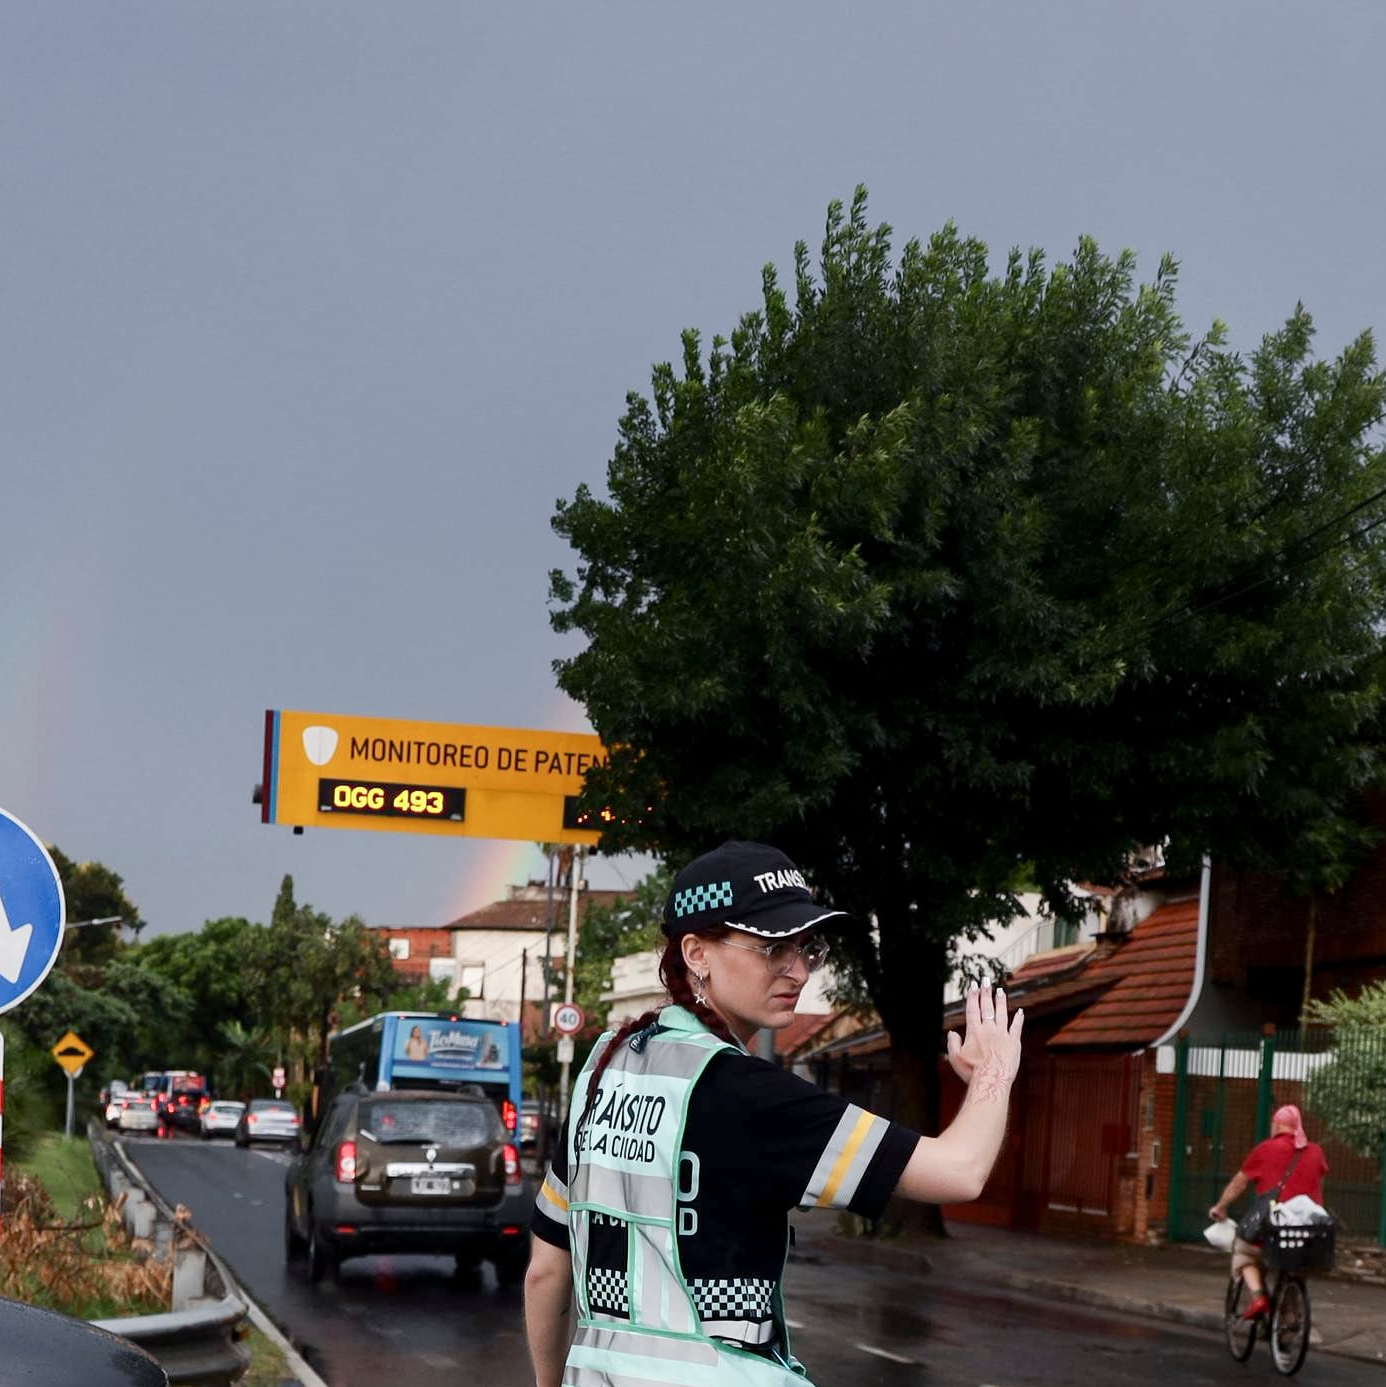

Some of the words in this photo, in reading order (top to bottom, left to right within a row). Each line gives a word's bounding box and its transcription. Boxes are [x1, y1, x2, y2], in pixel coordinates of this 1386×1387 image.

[350, 737, 489, 769] MONITOREO
[498, 748, 528, 772] DE
[333, 785, 385, 809] OGG
[393, 789, 444, 814] 493
[753, 869, 809, 893] TRANS
[559, 1013, 578, 1026] 40
